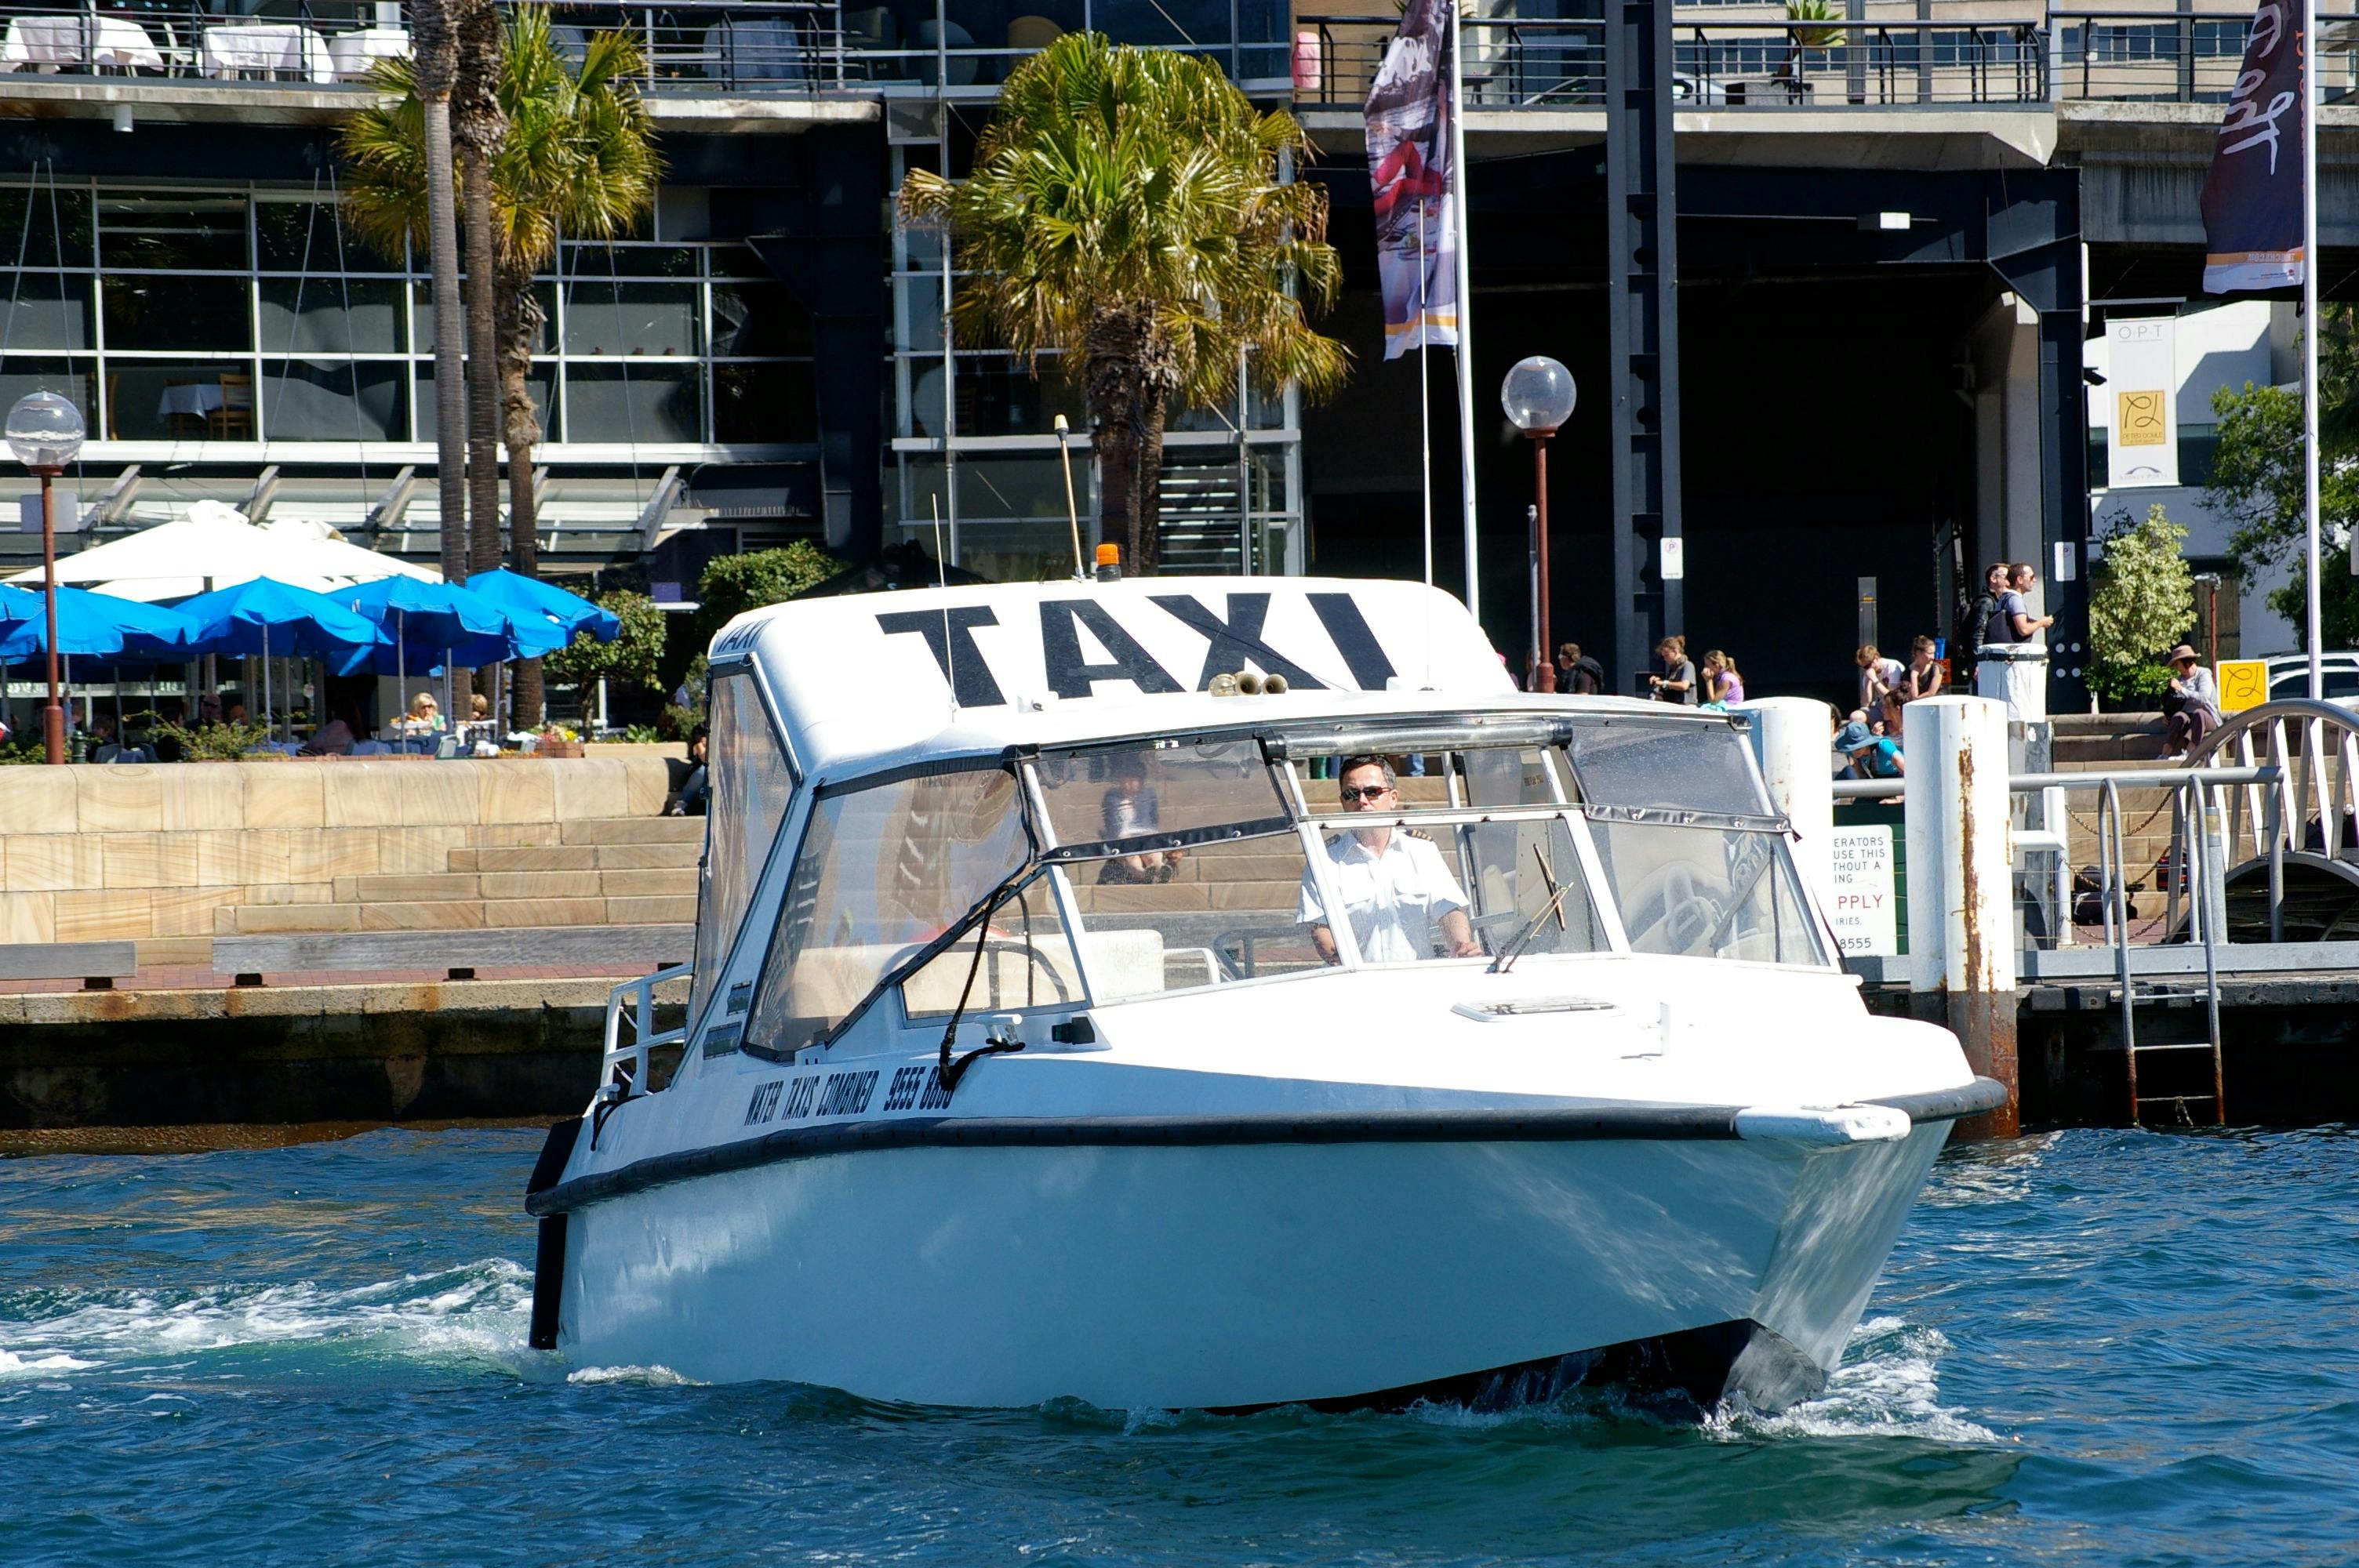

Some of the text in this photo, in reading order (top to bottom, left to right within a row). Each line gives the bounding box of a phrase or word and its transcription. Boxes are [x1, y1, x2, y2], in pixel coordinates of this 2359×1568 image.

[874, 593, 1398, 708] TAXI
[1833, 848, 1885, 859] USE THIS
[1874, 861, 1881, 869] A
[1834, 873, 1852, 884] ING
[1838, 894, 1883, 909] PPLY
[1839, 937, 1871, 949] 8555
[743, 1080, 784, 1126] WATER
[781, 1075, 820, 1120] TAXIS
[816, 1070, 880, 1116] COMBINED
[883, 1067, 927, 1112] 9555
